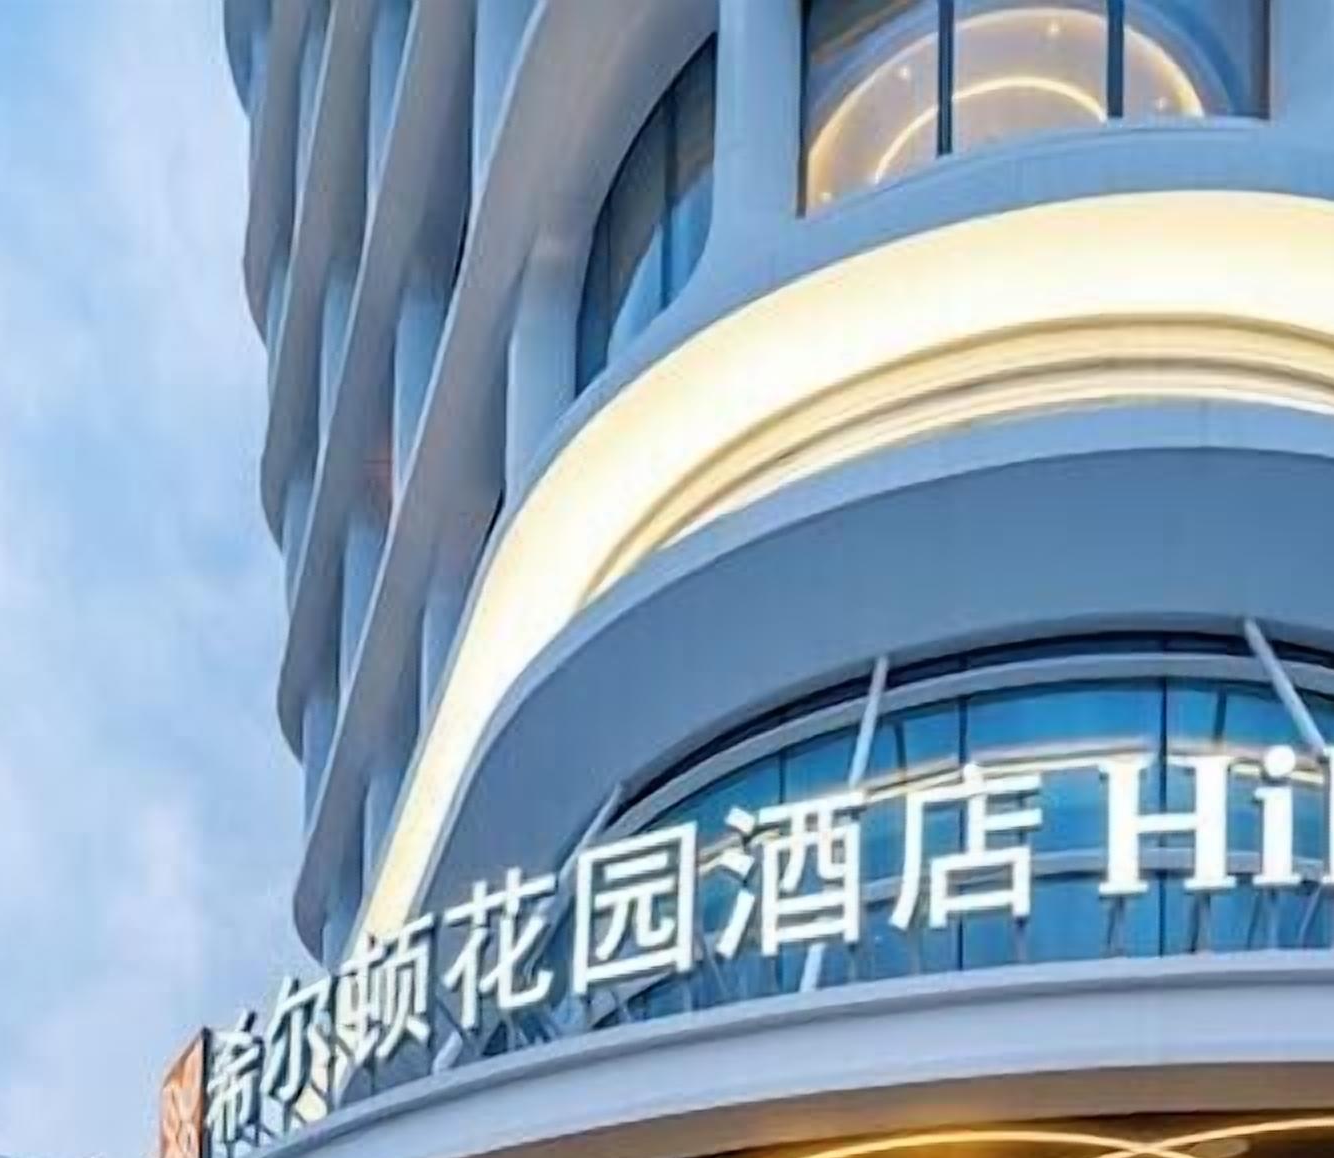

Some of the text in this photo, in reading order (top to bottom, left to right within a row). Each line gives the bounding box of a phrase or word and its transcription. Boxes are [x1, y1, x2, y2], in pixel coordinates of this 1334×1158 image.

[206, 763, 1042, 1144] 希尔顿花园酒店
